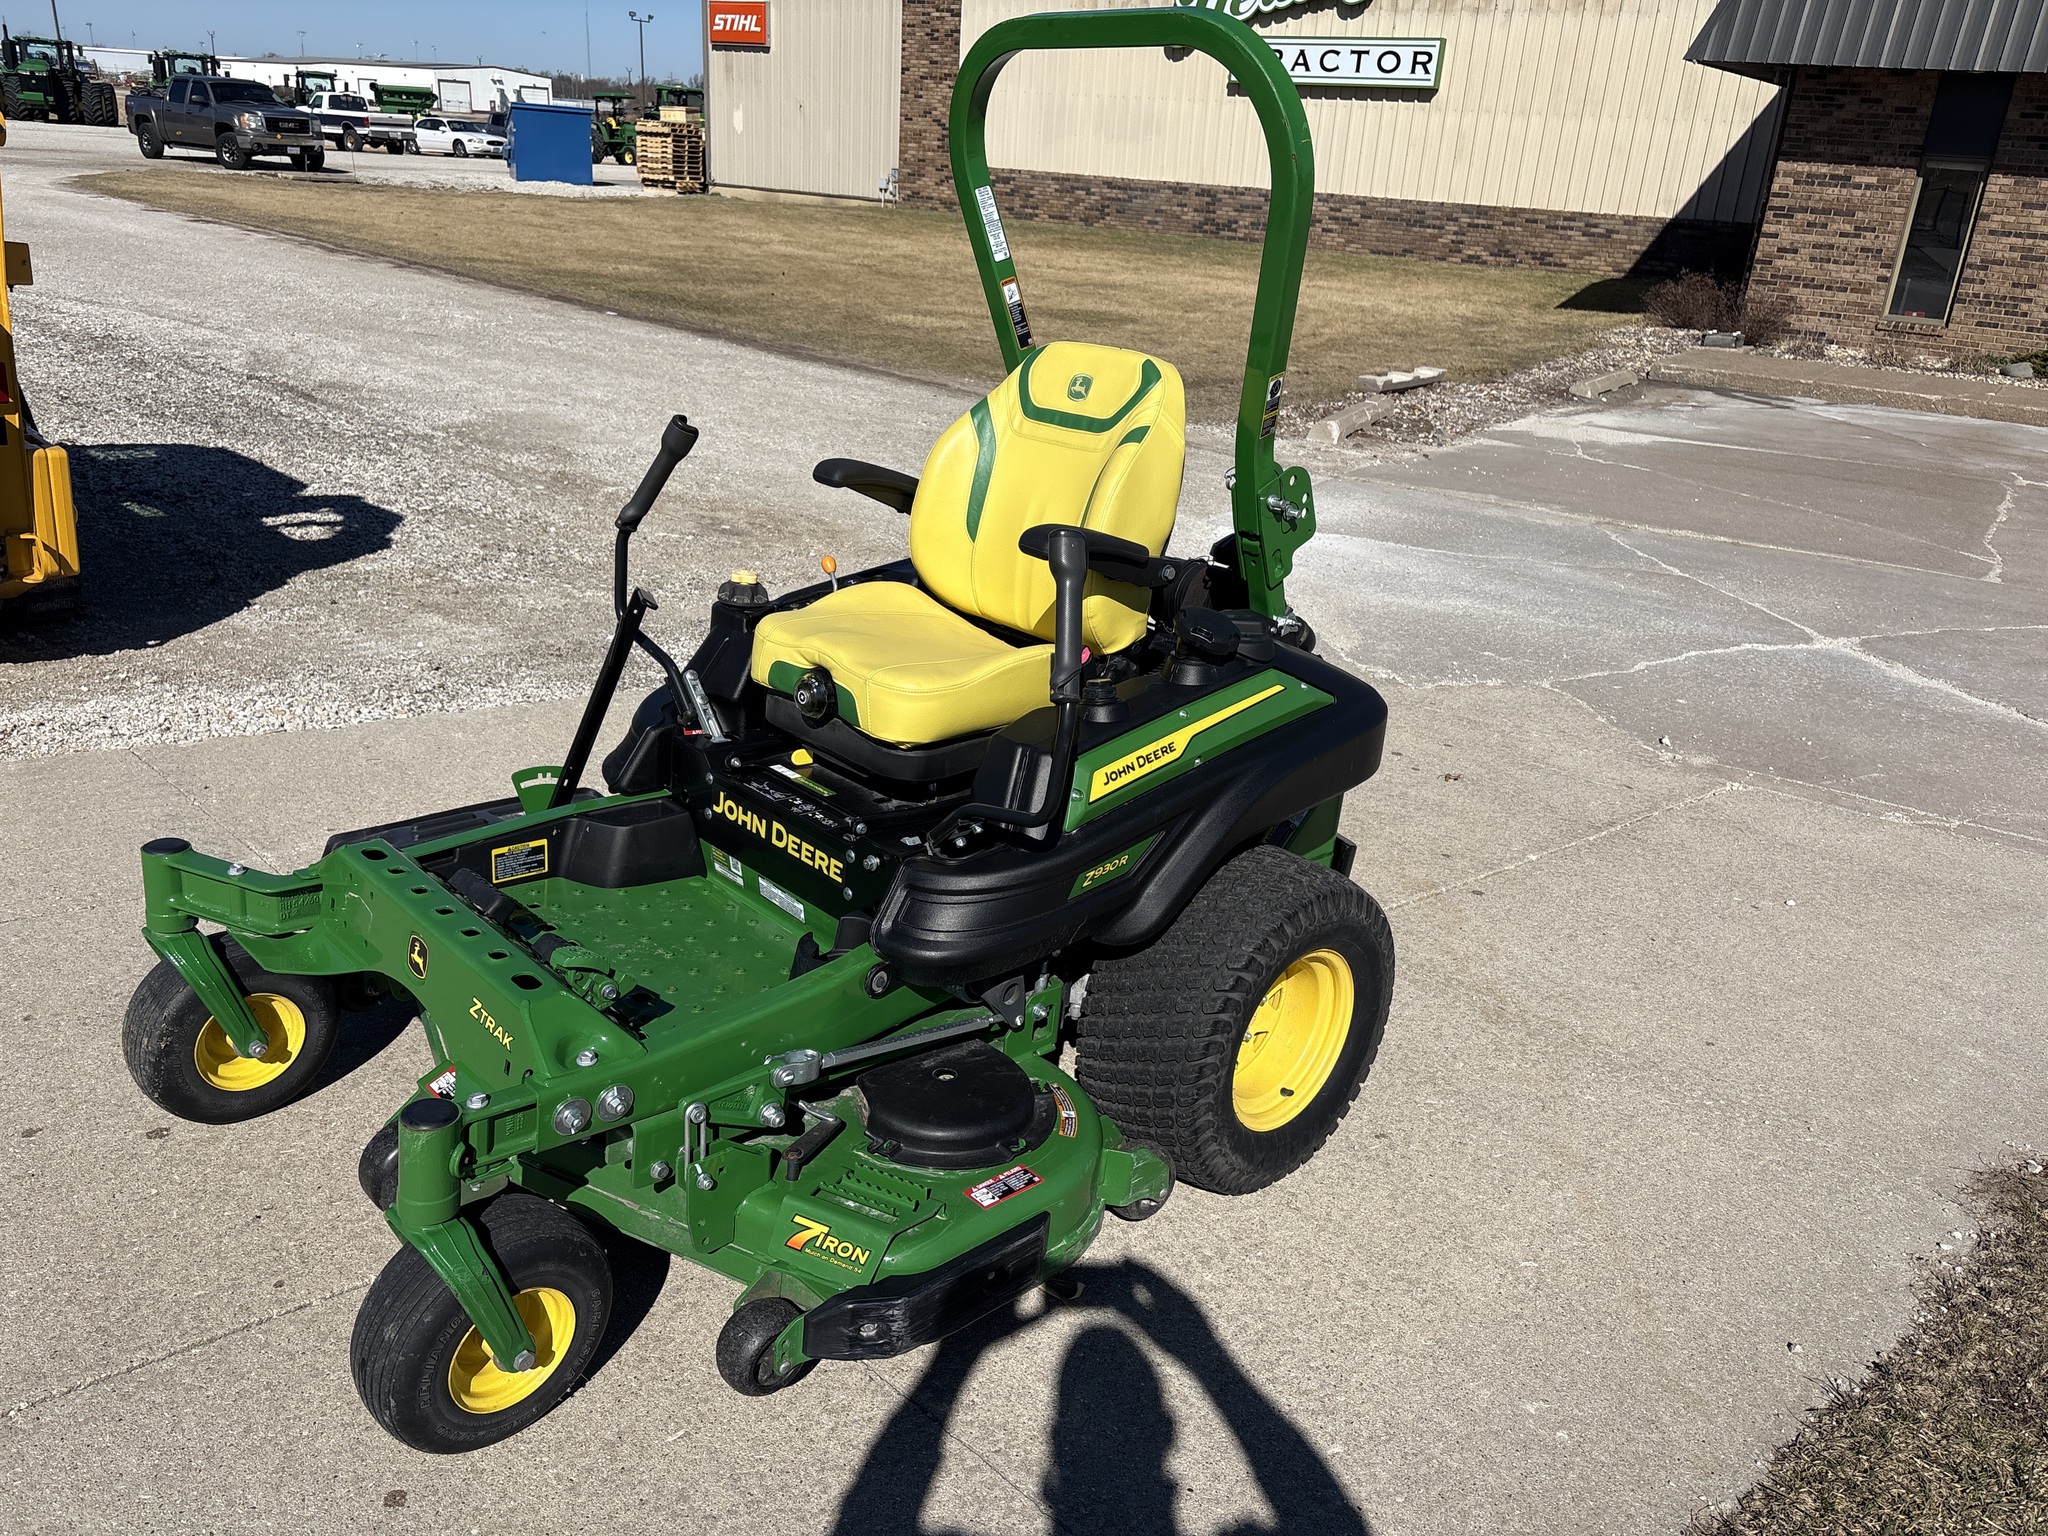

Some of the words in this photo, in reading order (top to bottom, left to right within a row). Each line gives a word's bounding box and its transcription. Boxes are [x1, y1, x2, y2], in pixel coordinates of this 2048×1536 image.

[713, 14, 761, 32] STIHL
[1271, 48, 1433, 75] ACTOR
[1102, 762, 1136, 786] JOHN
[1136, 741, 1177, 769] DEERE
[713, 791, 767, 839] JOHN
[771, 820, 844, 883] DEERE
[1082, 854, 1129, 888] Z930R
[468, 997, 514, 1052] ZTRAK
[804, 1247, 821, 1257] Mulch
[418, 1313, 464, 1410] RELIANC
